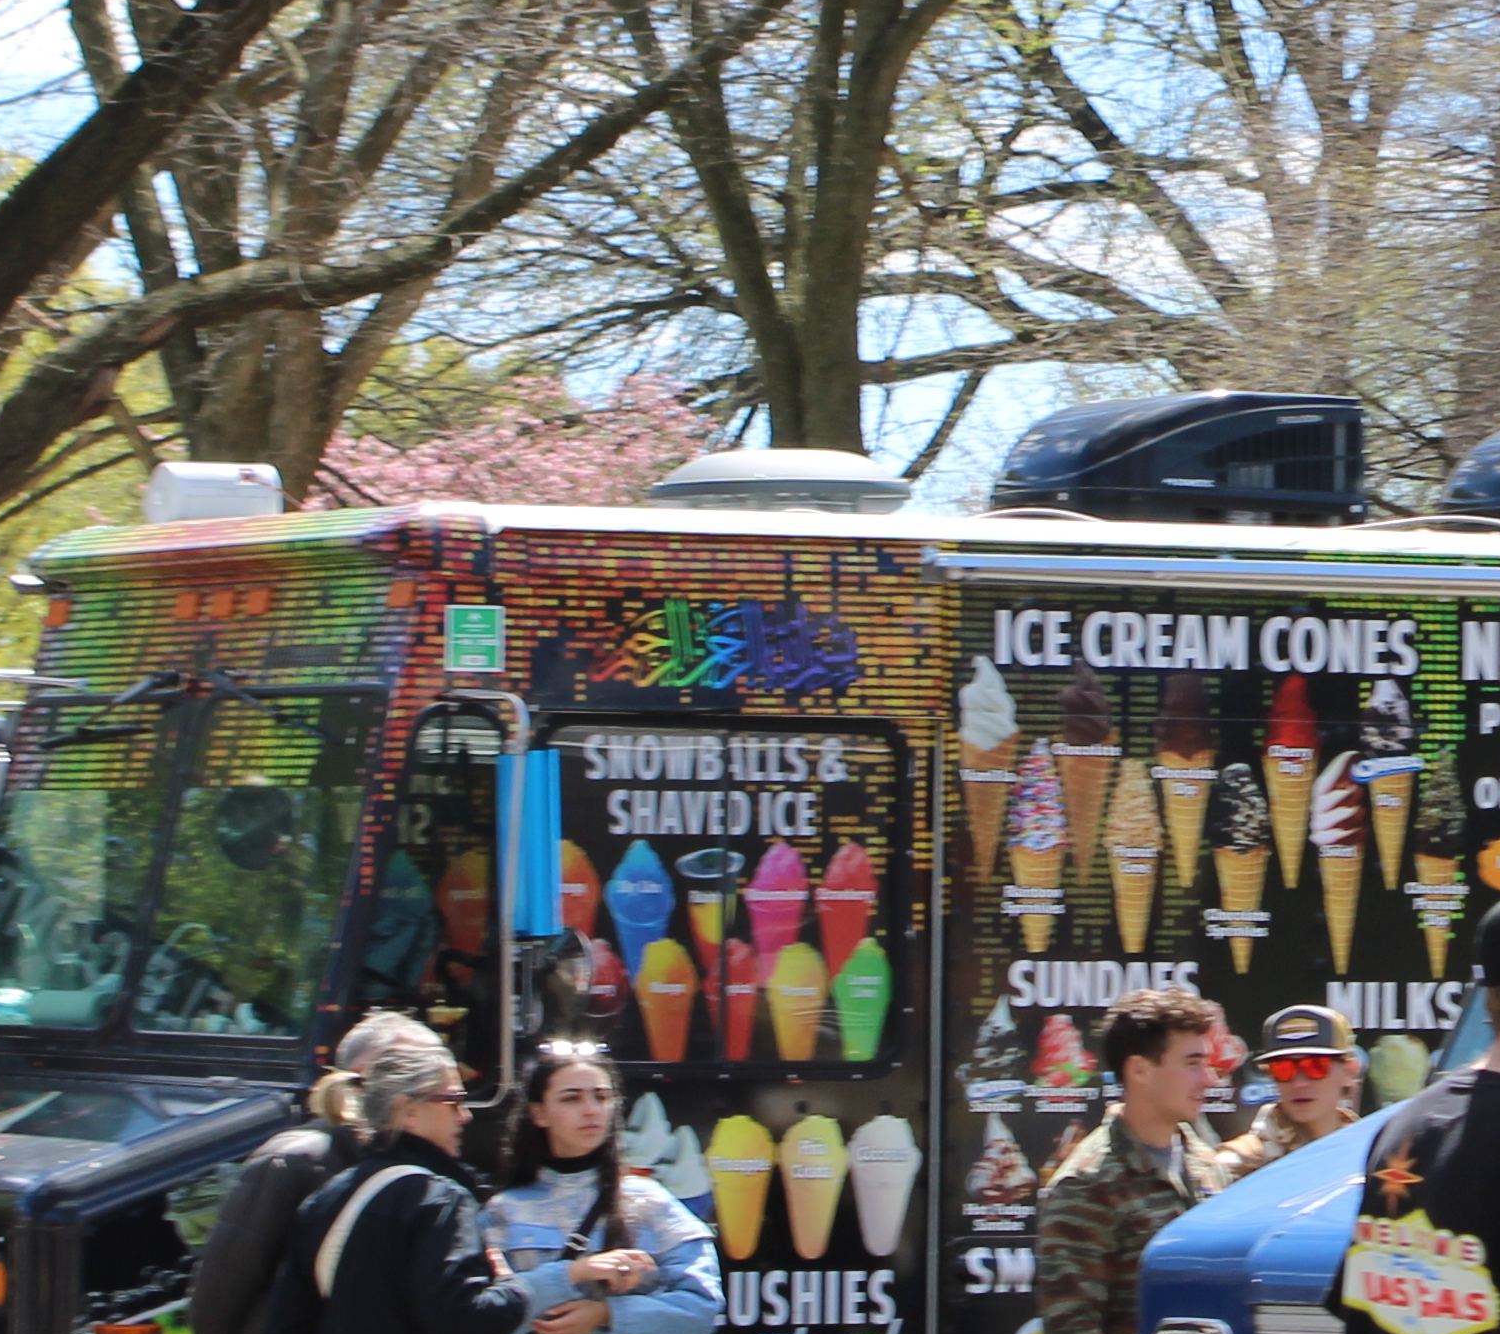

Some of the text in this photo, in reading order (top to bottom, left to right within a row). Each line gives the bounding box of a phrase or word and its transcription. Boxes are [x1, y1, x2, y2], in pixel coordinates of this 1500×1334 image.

[994, 609, 1419, 675] ICE CREAM CONES
[583, 734, 809, 782] SNOWBALLS
[607, 789, 817, 836] SHAVED ICE
[1326, 981, 1475, 1030] MILKS
[713, 1269, 897, 1327] USHIES
